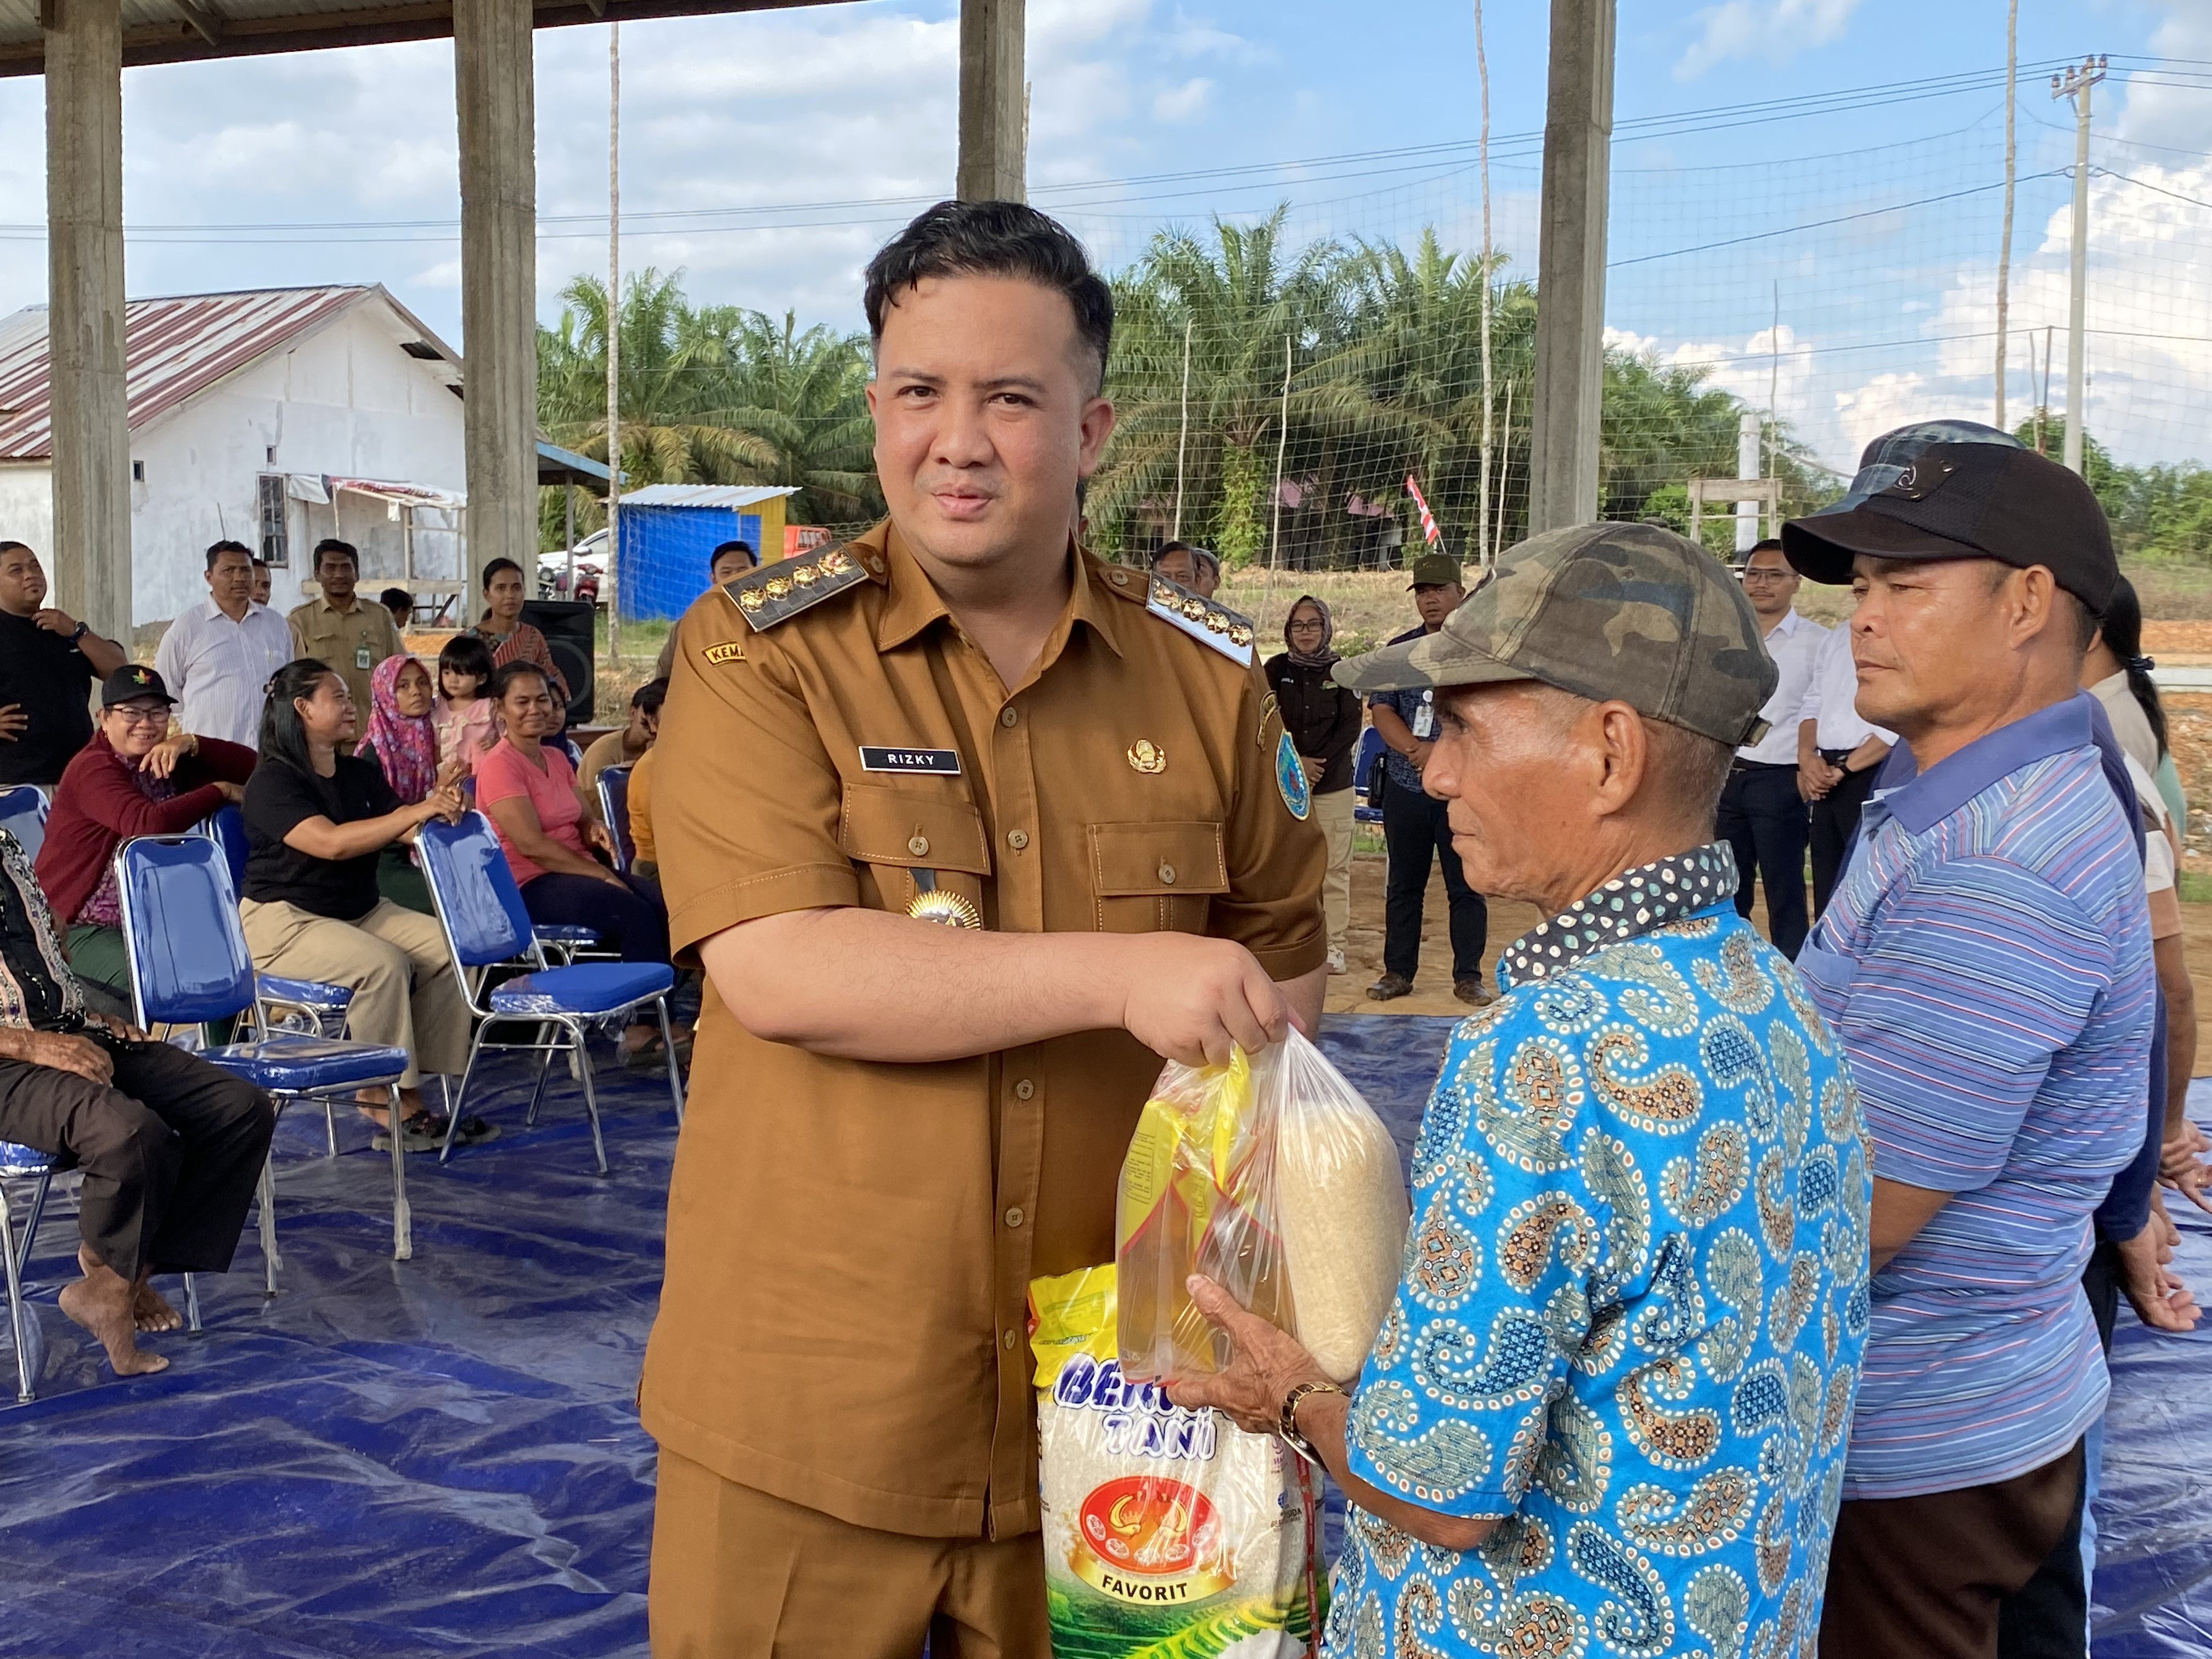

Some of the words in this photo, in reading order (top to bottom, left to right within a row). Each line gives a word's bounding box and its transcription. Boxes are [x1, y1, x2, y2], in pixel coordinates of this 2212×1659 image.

[887, 754, 934, 765] RIZKY
[1102, 1413, 1217, 1461] TANI
[1102, 1574, 1187, 1600] FAVORIT
